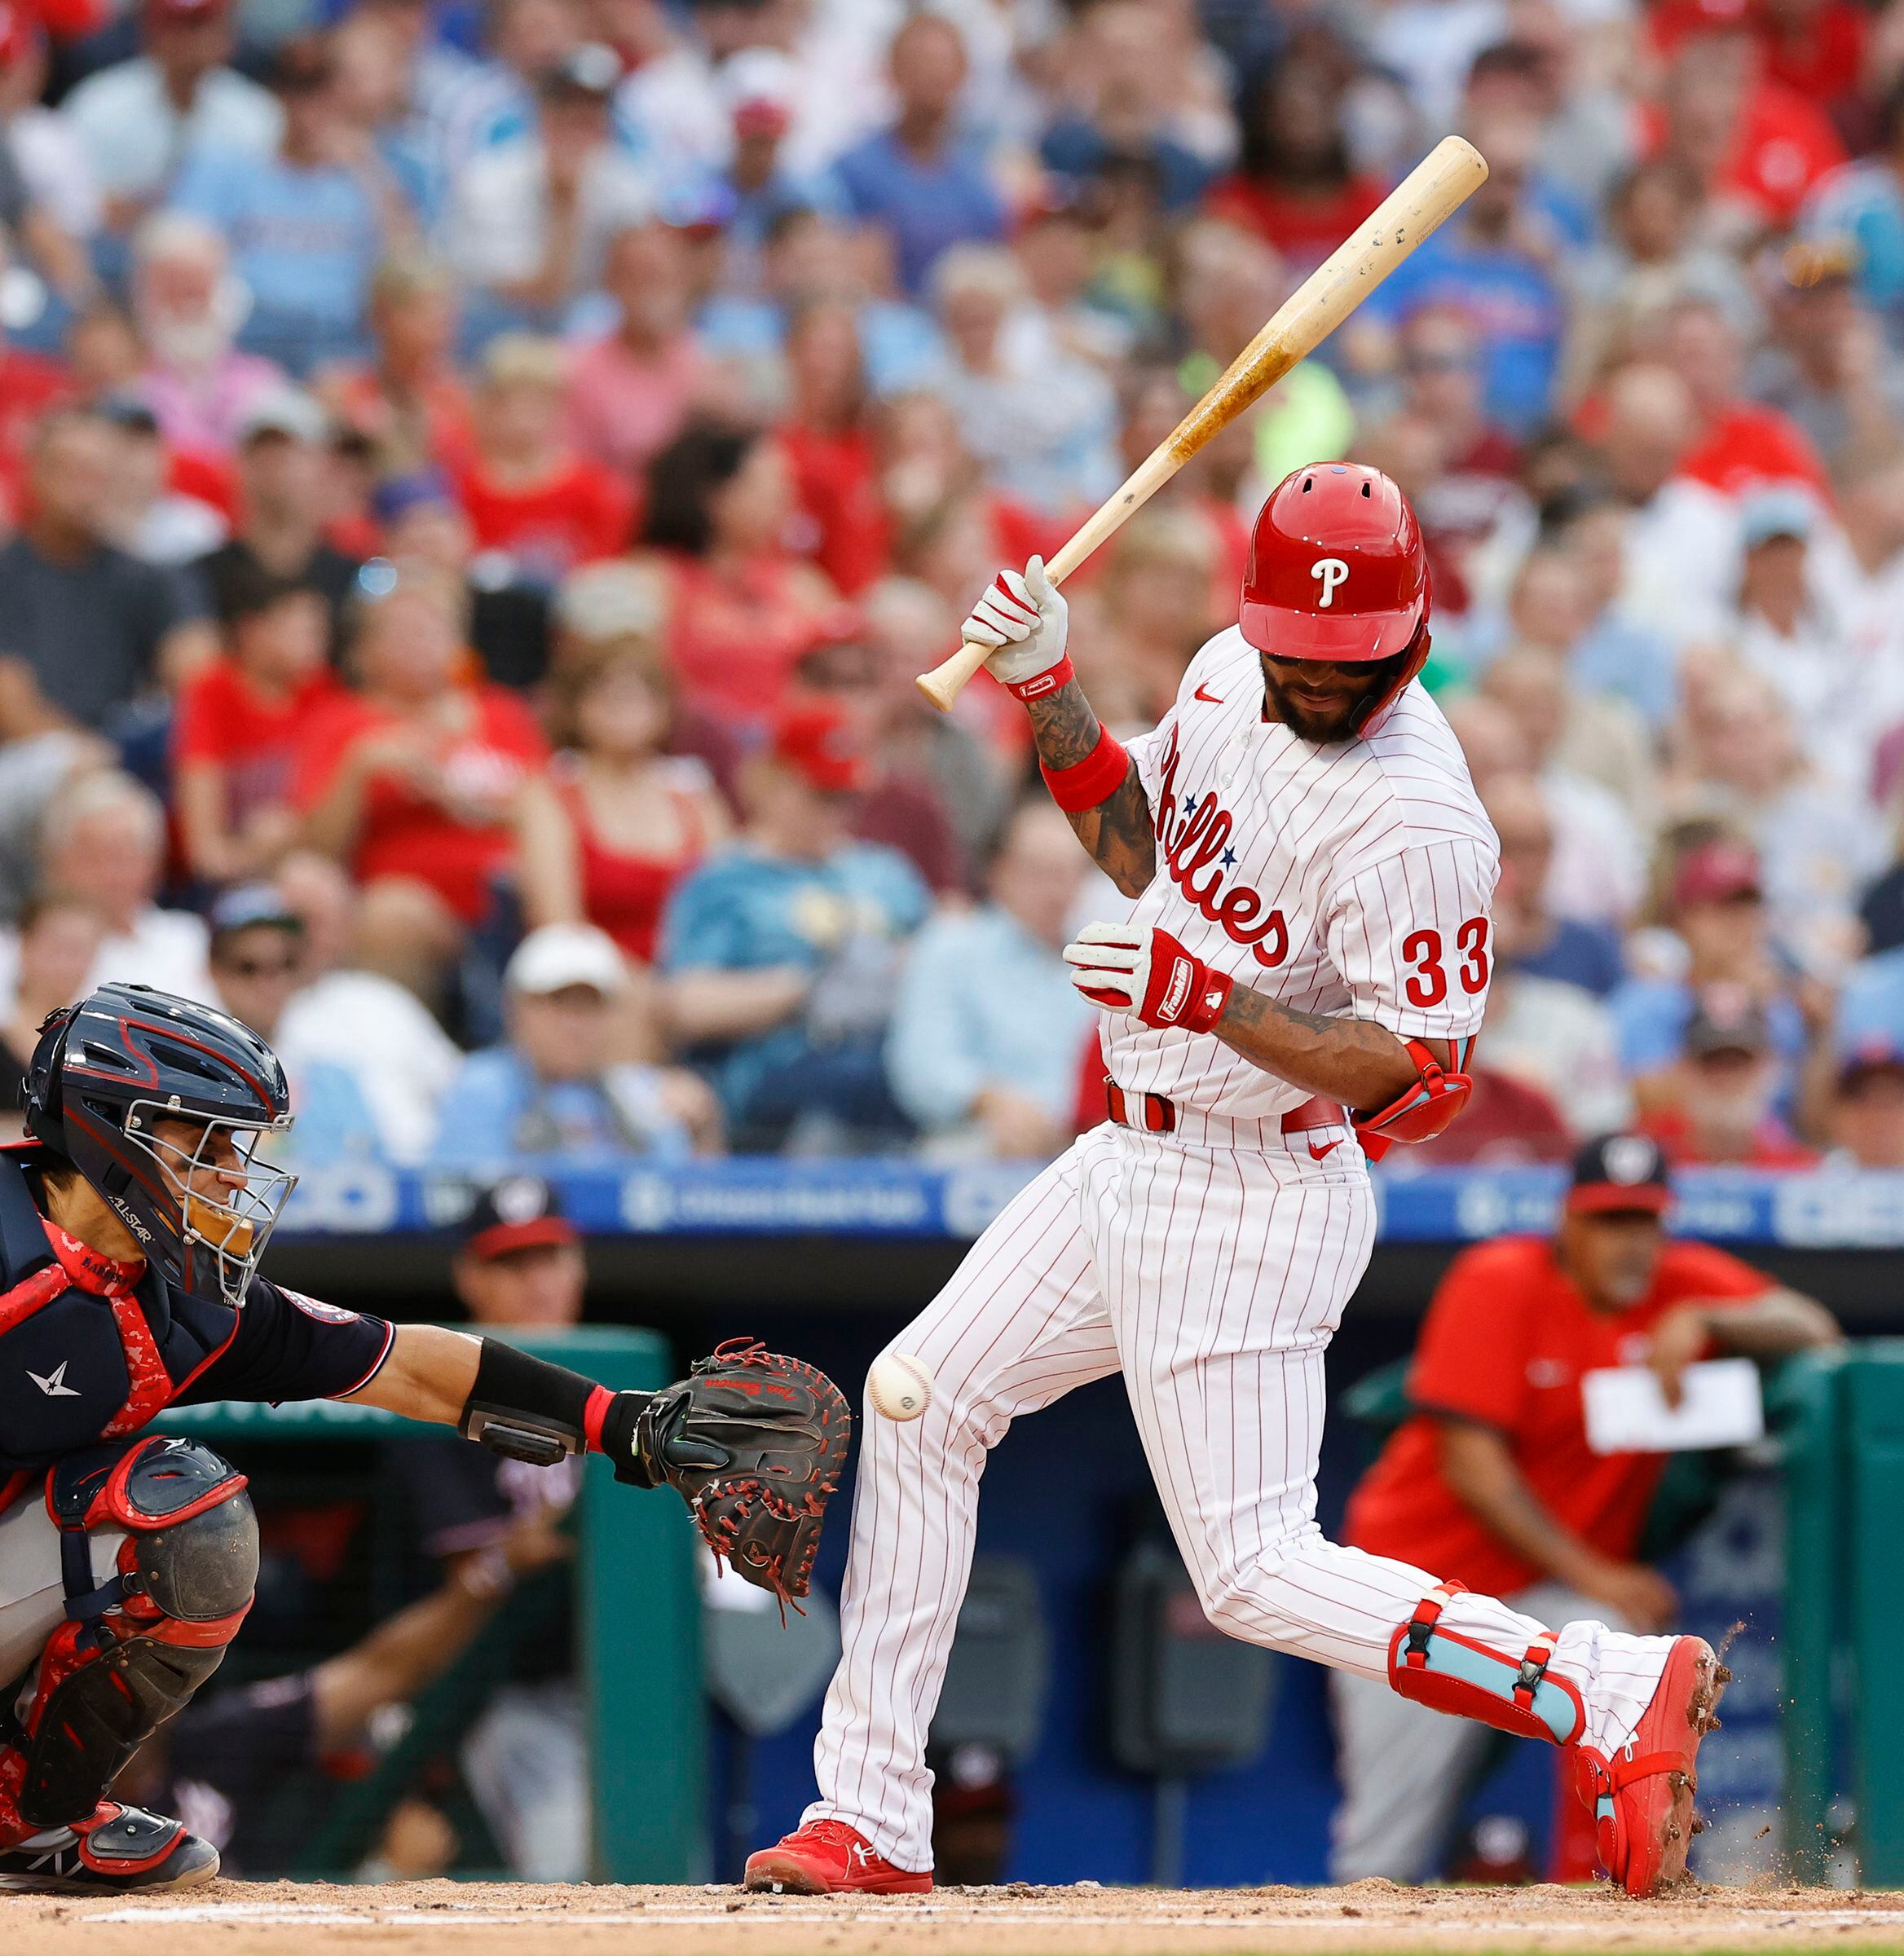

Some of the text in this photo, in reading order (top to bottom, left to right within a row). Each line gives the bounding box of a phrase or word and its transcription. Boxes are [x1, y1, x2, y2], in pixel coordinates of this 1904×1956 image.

[1311, 557, 1350, 608] P
[1161, 959, 1189, 1020] Franklin
[1402, 916, 1488, 1008] 33
[107, 1195, 152, 1245] ALL-STAR
